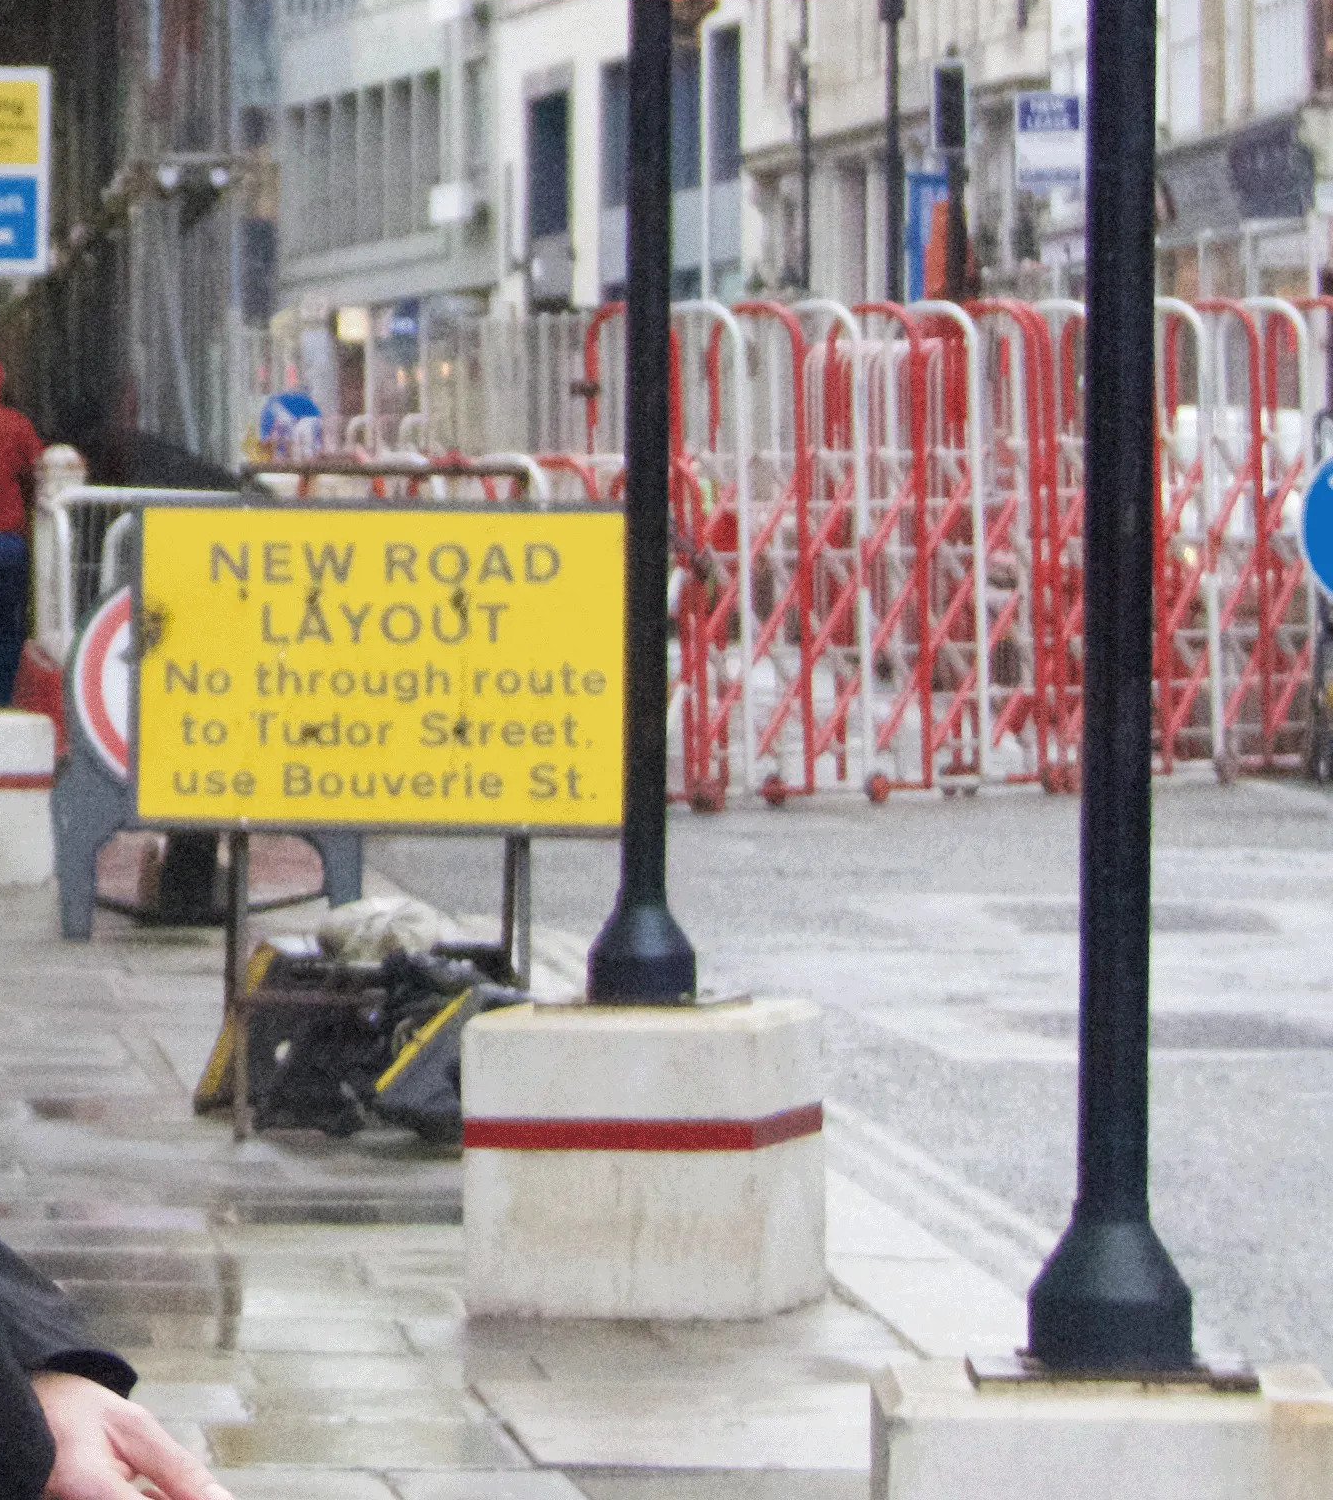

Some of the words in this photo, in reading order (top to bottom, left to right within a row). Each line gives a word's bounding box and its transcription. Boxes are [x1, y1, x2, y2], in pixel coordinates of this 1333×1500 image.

[210, 542, 355, 585] NEW
[384, 543, 562, 585] ROAD
[261, 602, 509, 645] LAYOUT
[164, 660, 232, 696] No
[255, 661, 452, 704] through
[472, 664, 607, 697] route
[181, 714, 229, 747] to
[255, 711, 393, 747] Tudor
[172, 770, 257, 799] use
[282, 762, 504, 800] Bouverie
[528, 763, 600, 801] St.
